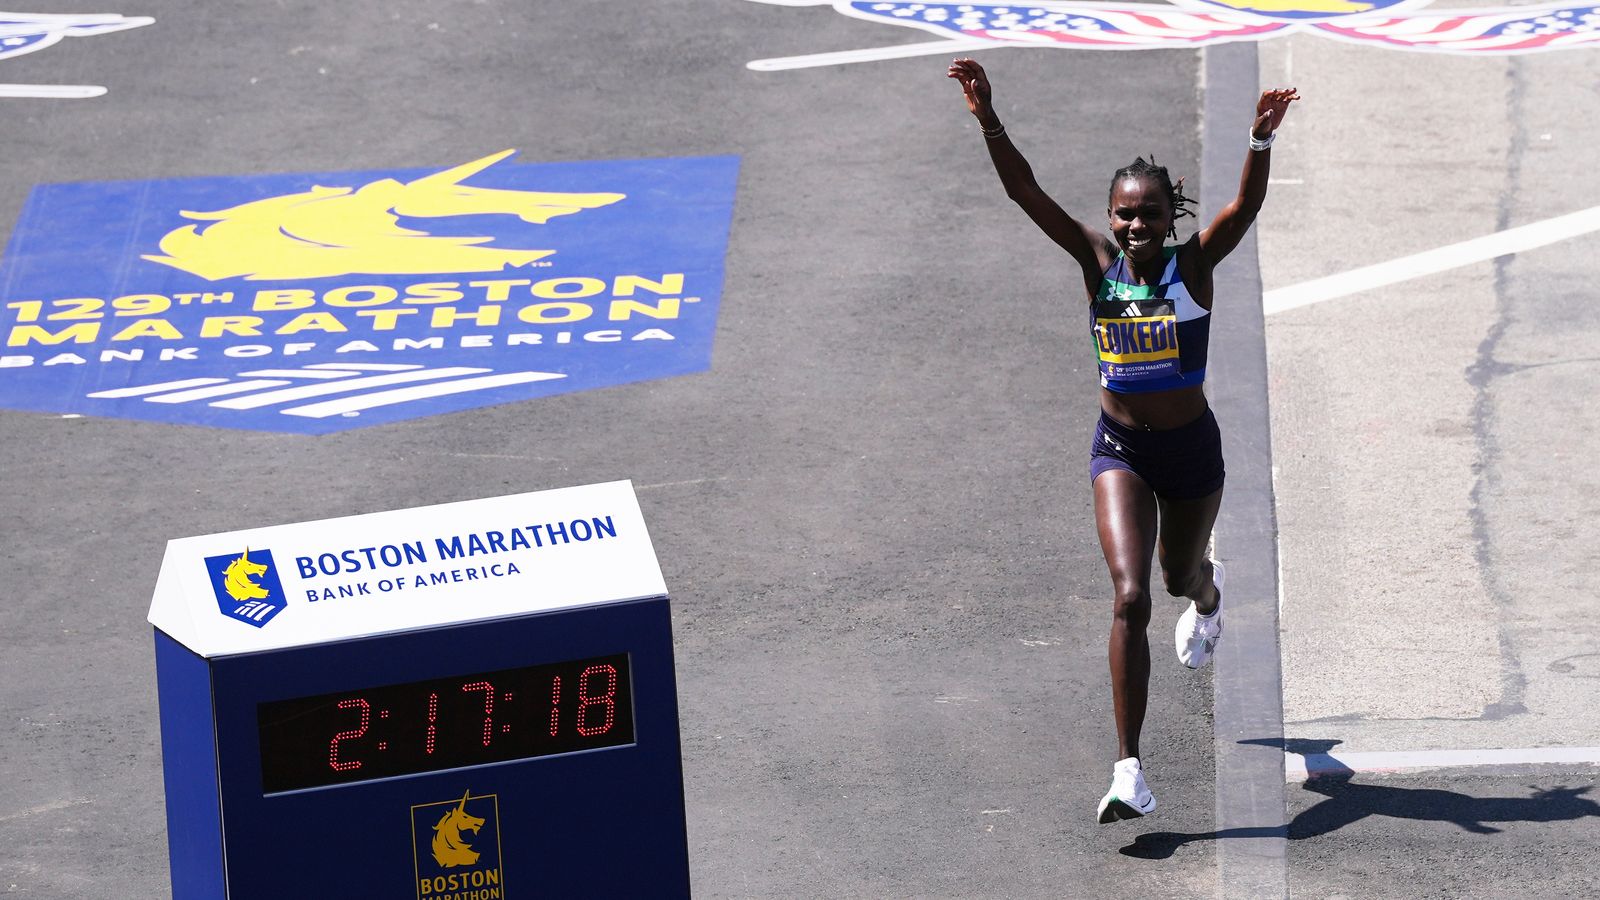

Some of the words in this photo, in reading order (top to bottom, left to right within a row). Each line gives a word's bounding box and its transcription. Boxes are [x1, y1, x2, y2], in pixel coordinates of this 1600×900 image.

[6, 291, 234, 322] 129TH
[252, 273, 684, 311] BOSTON
[6, 298, 681, 347] MARATHON
[1097, 320, 1177, 355] LOKEDI
[0, 347, 199, 368] BANK
[224, 342, 316, 358] OF
[336, 328, 676, 352] AMERICA
[296, 541, 428, 579] BOSTON
[435, 515, 617, 560] MARATHON
[306, 582, 371, 602] BANK
[378, 577, 406, 592] OF
[414, 562, 521, 588] AMERICA
[329, 664, 616, 771] 2:17:18
[420, 868, 499, 894] BOSTON
[422, 887, 499, 900] RATHON
